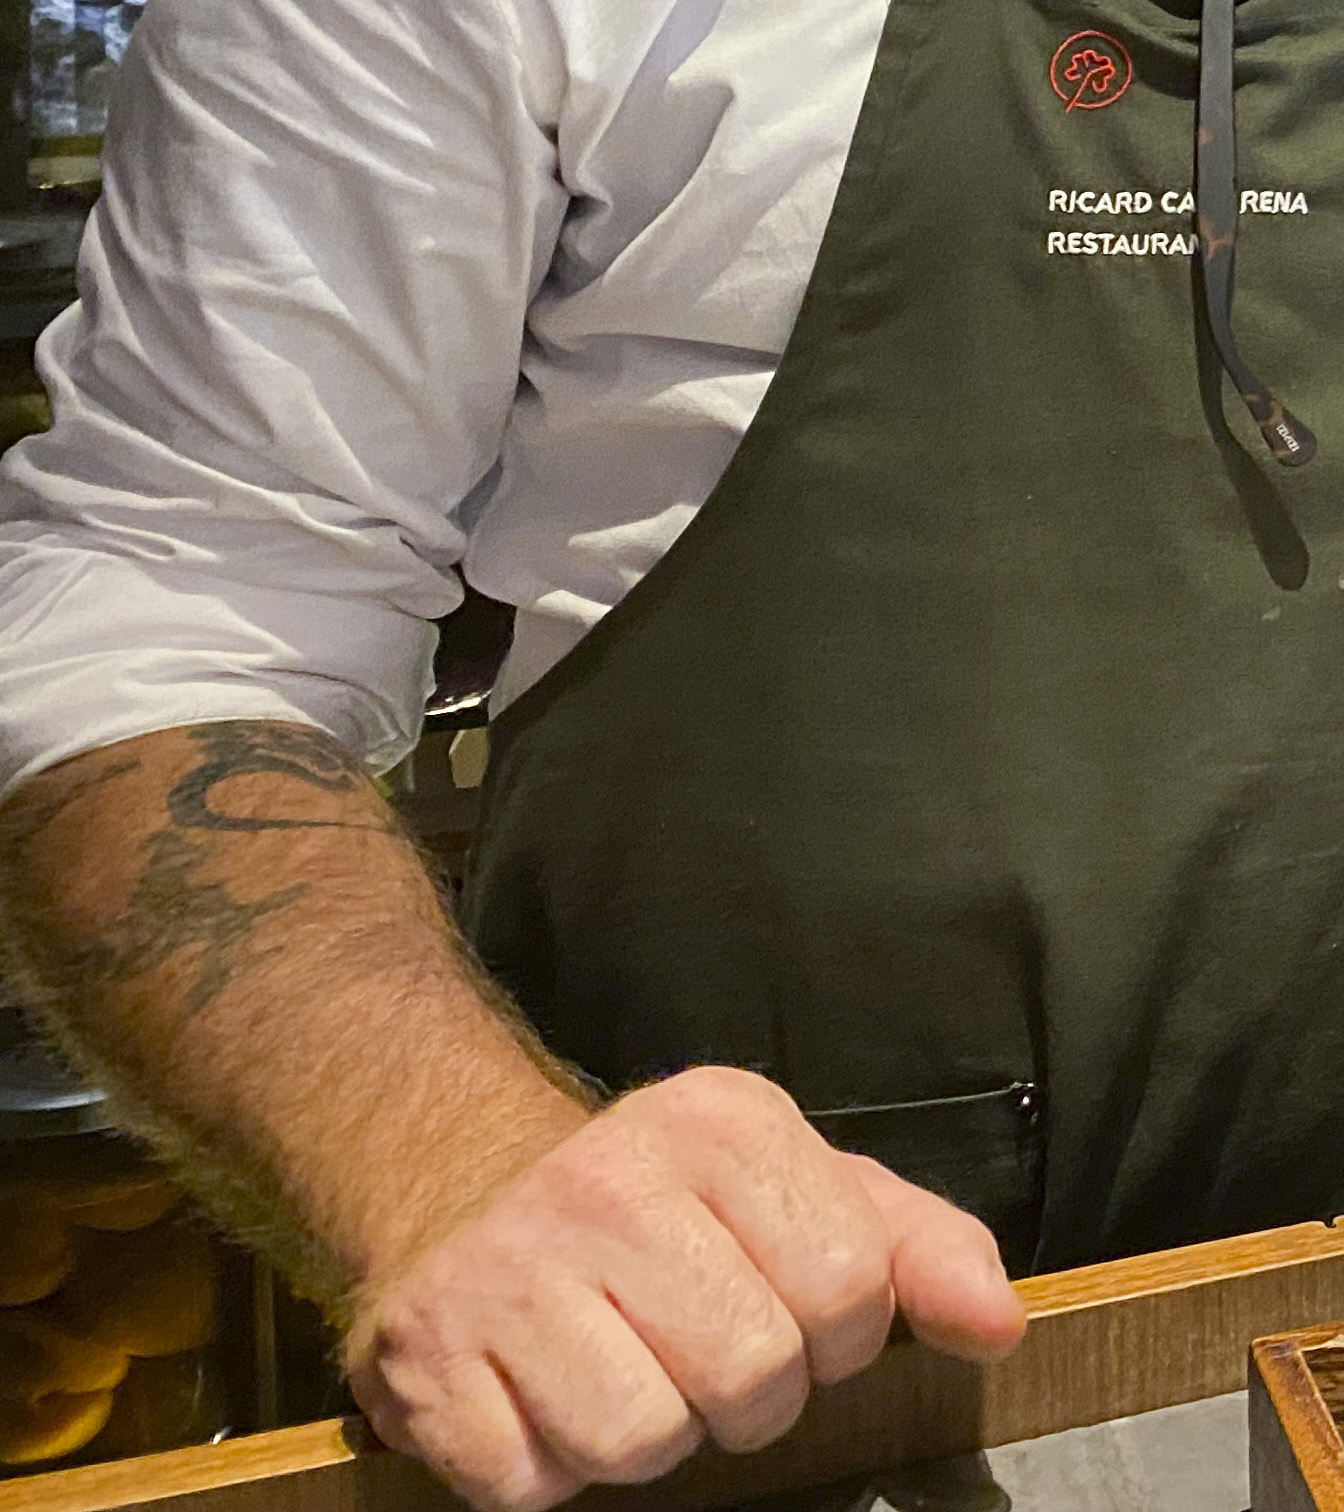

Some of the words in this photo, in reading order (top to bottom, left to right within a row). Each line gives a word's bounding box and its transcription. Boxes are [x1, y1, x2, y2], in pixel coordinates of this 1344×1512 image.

[1049, 189, 1153, 214] RICARD
[1160, 190, 1309, 215] CARENA
[1048, 231, 1200, 255] RESTAURAN
